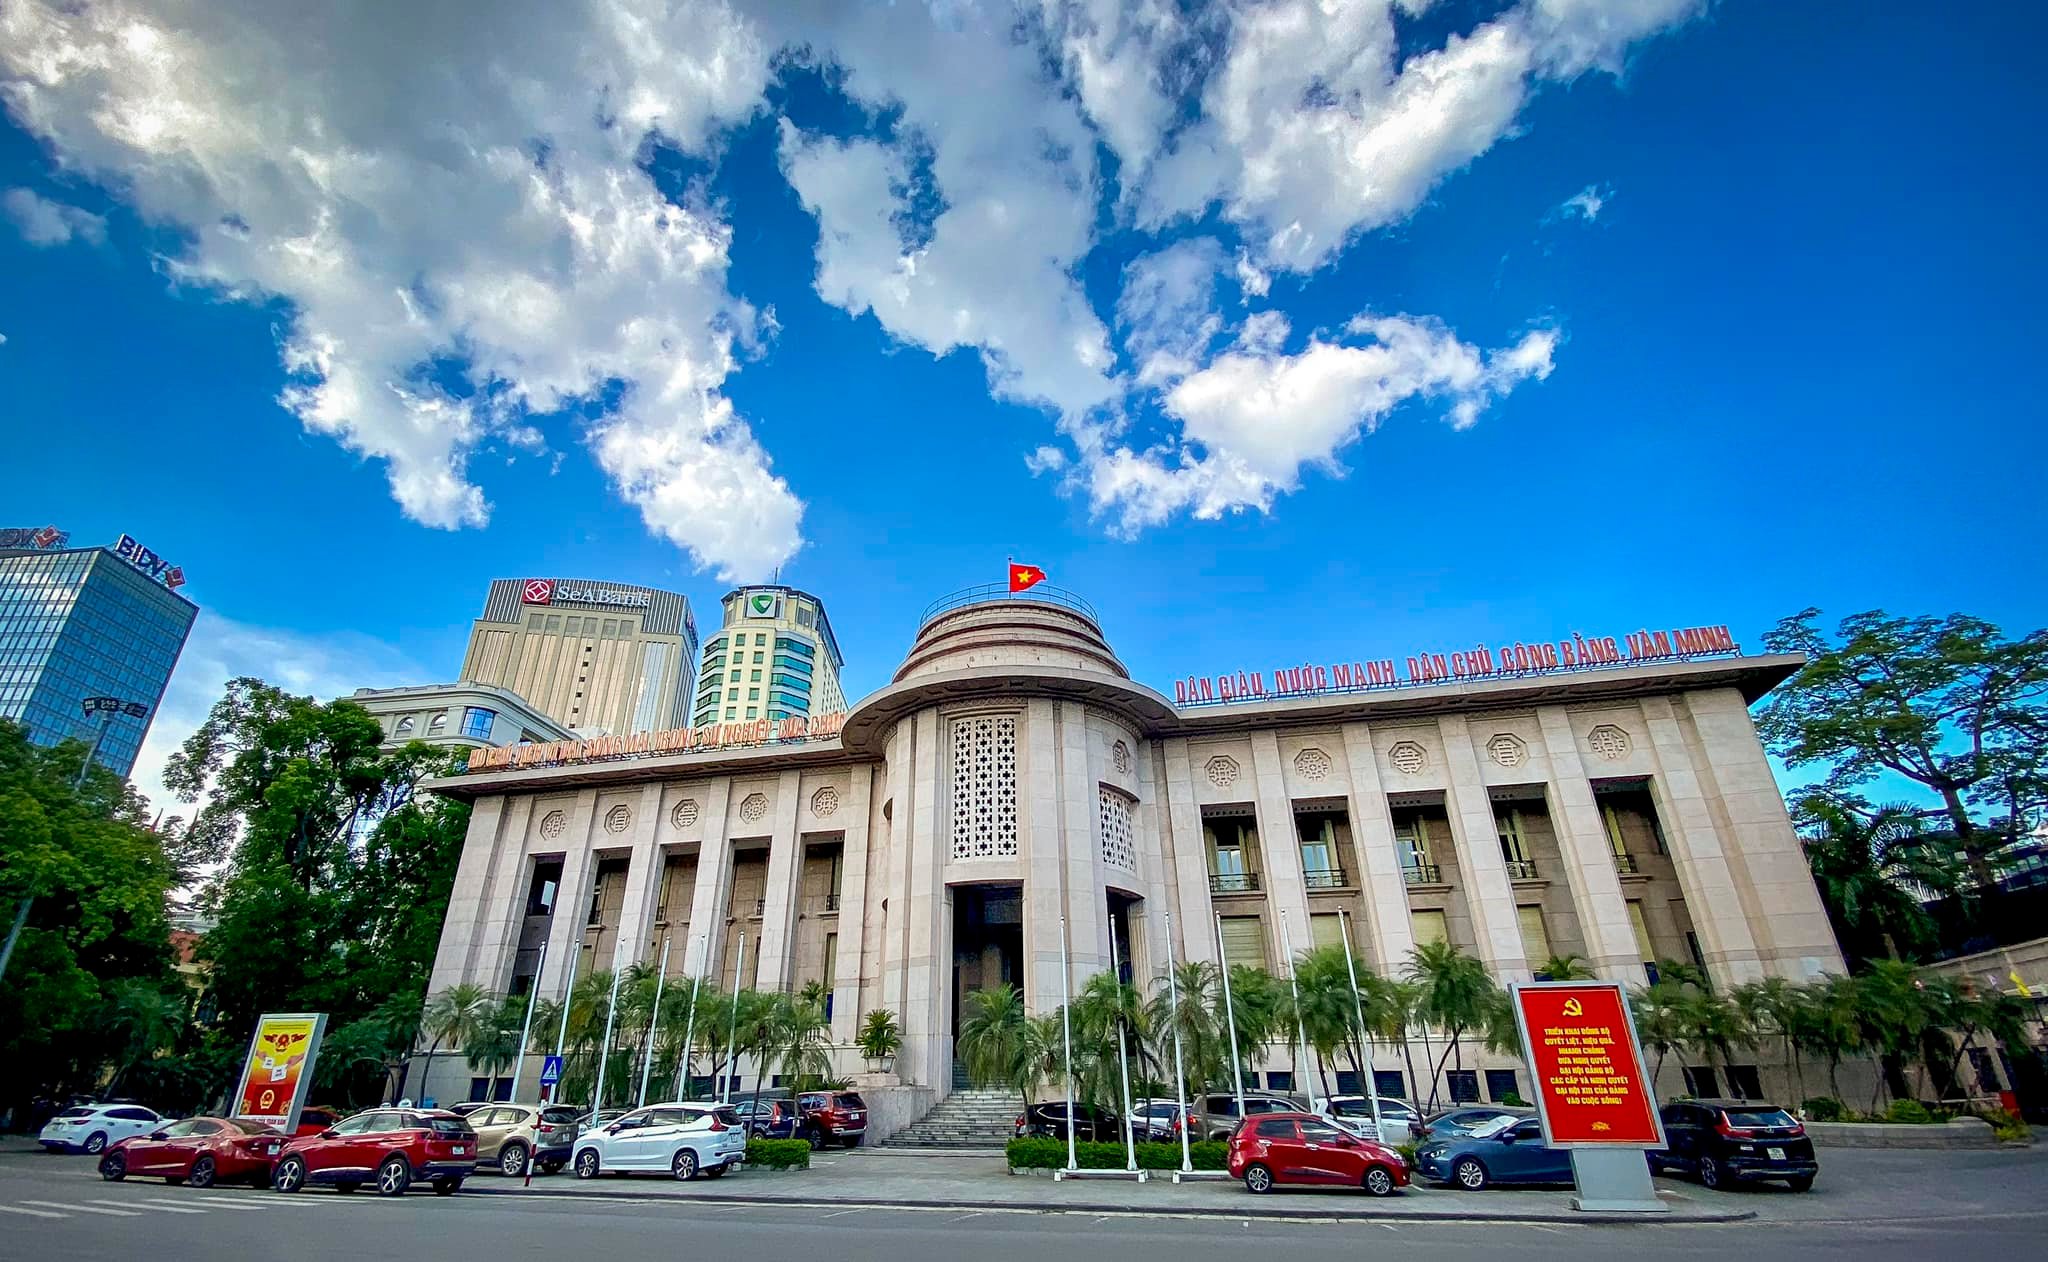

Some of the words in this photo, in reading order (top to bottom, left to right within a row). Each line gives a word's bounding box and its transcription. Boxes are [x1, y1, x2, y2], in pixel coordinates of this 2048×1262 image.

[115, 533, 168, 577] BIDV
[556, 586, 650, 606] SeABank
[1175, 675, 1213, 702] DÂN
[1275, 662, 1327, 692] NƯỚC
[1407, 652, 1448, 681] DÂN
[1501, 642, 1558, 671] CÔNG
